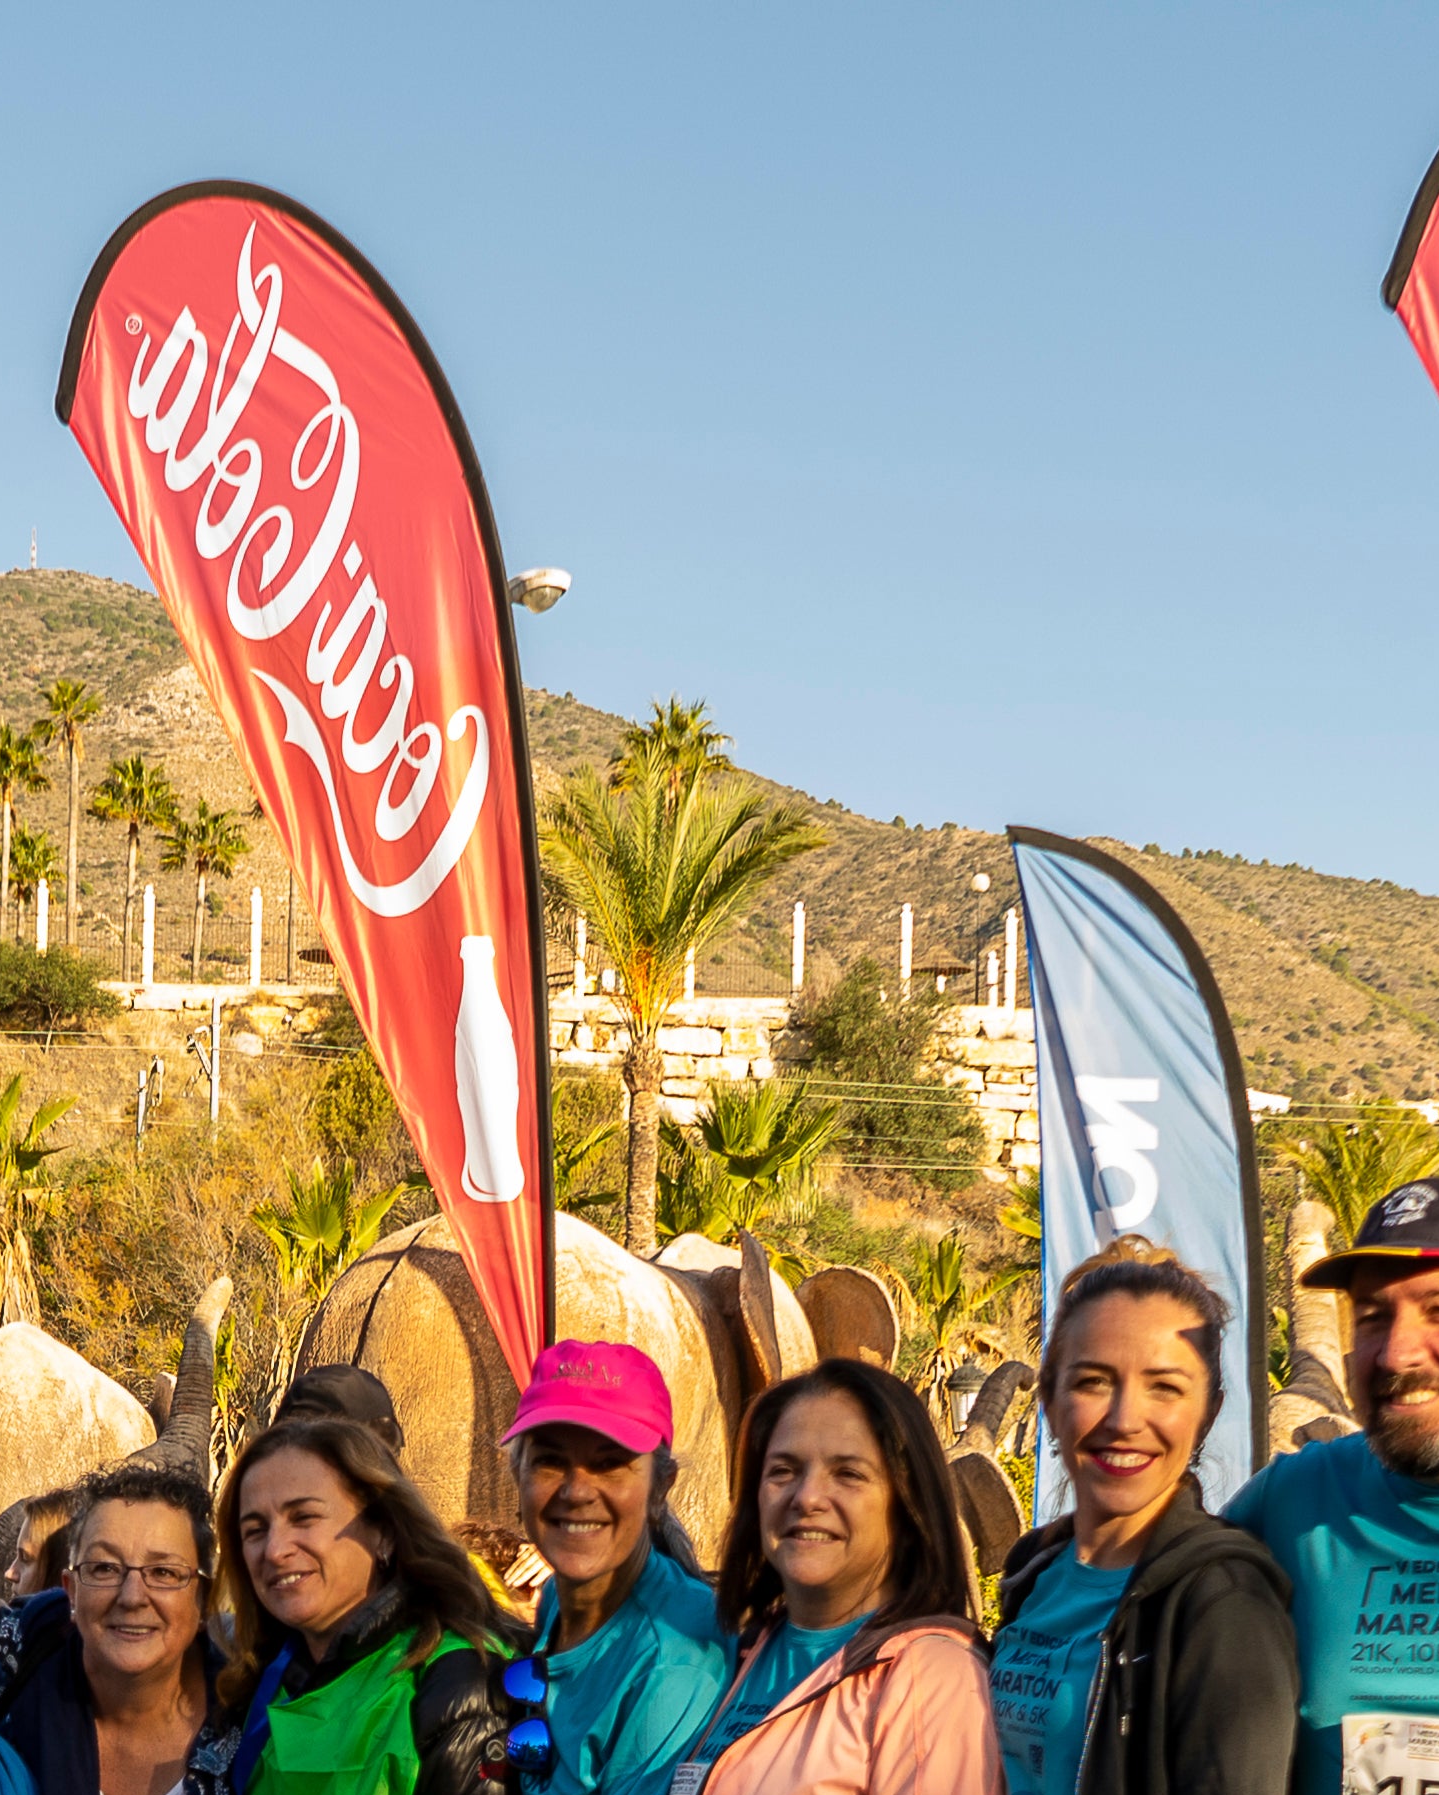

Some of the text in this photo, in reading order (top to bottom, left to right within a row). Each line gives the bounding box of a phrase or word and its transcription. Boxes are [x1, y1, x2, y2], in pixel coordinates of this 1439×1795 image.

[1395, 1560, 1408, 1575] V
[1351, 1642, 1400, 1665] 21K,
[1029, 1706, 1050, 1726] 5K
